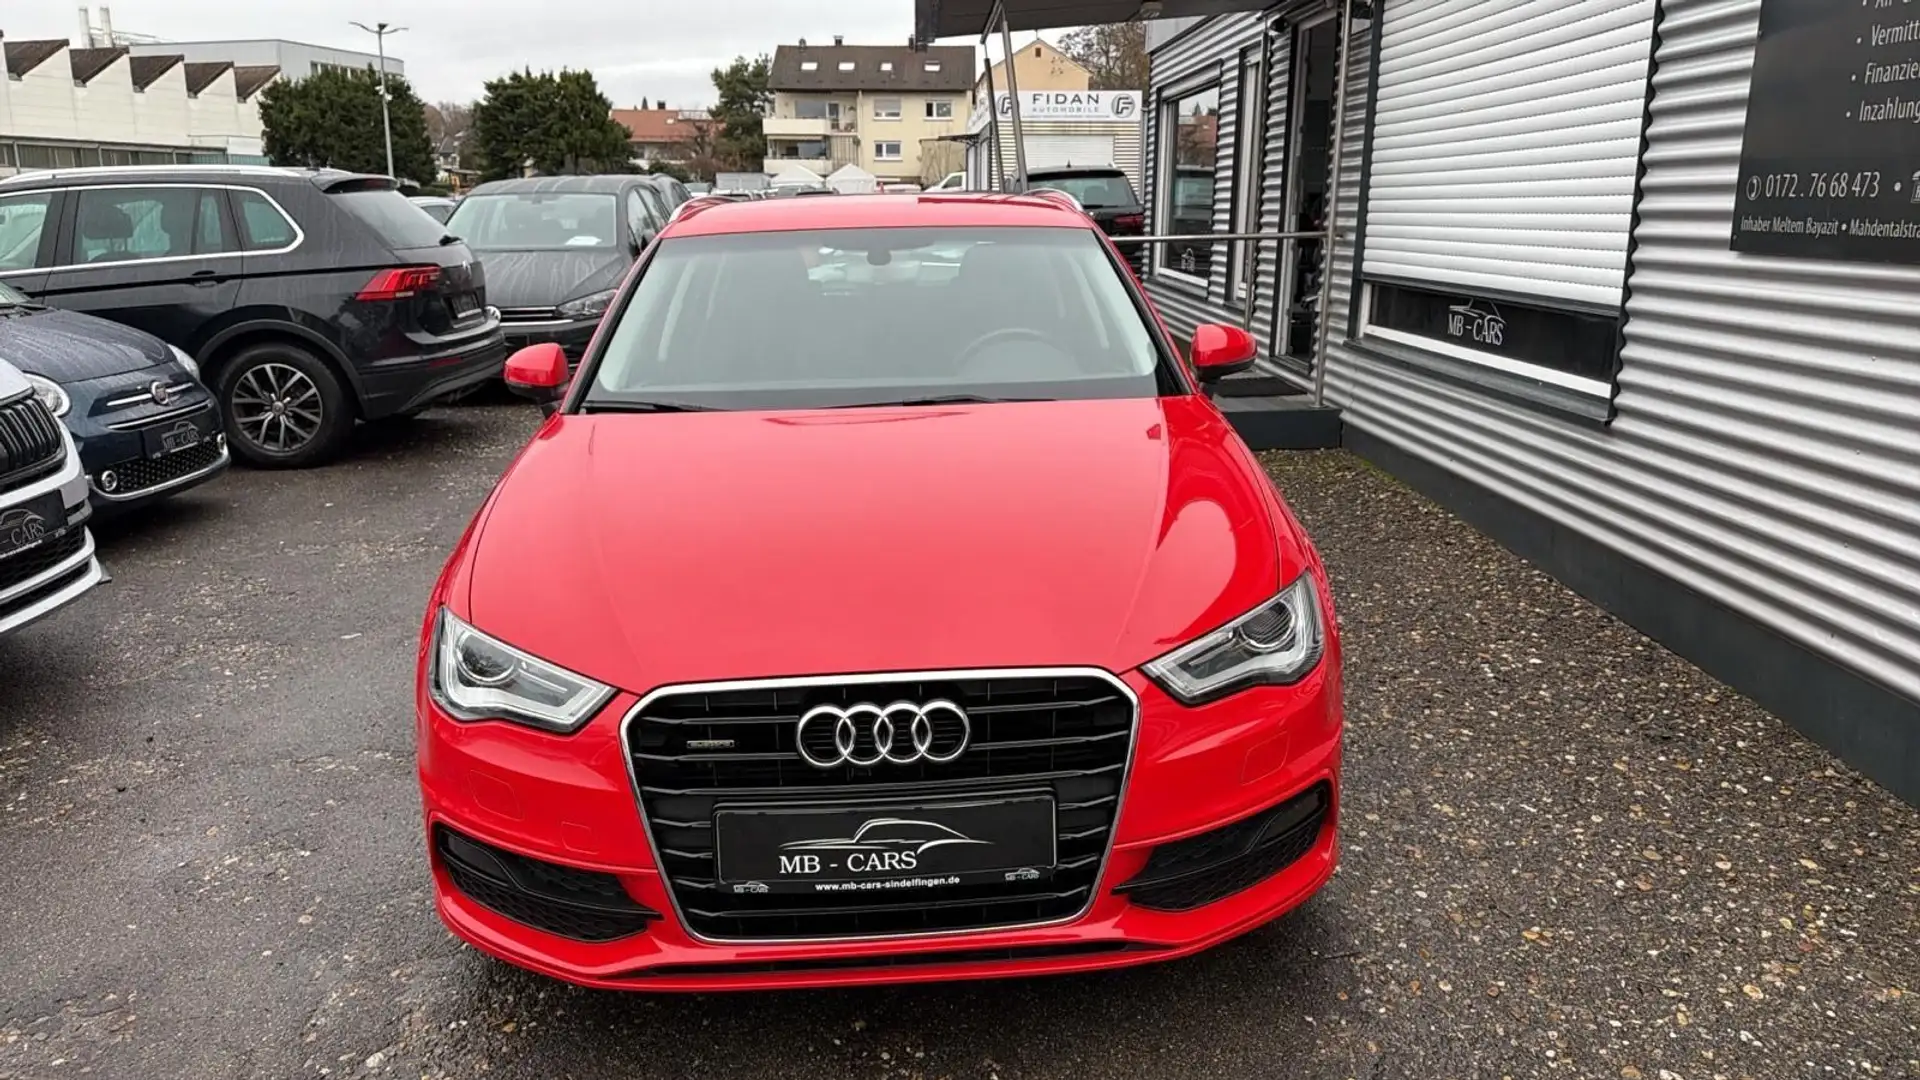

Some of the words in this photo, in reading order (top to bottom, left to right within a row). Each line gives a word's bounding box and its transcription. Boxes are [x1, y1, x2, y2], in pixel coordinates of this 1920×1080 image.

[1872, 20, 1920, 46] Vermitt
[1865, 58, 1920, 84] Finanzie
[1032, 93, 1100, 104] FIDAN
[1741, 215, 1771, 231] Inhaber
[1772, 216, 1804, 232] Meltem
[1806, 217, 1839, 239] Bayazit
[1448, 313, 1464, 336] MB
[1473, 319, 1504, 345] CARS
[11, 520, 45, 546] CARS
[779, 855, 820, 874] MB
[847, 851, 917, 872] CARS
[815, 876, 960, 892] www.mb-cars-sindelfingen.de
